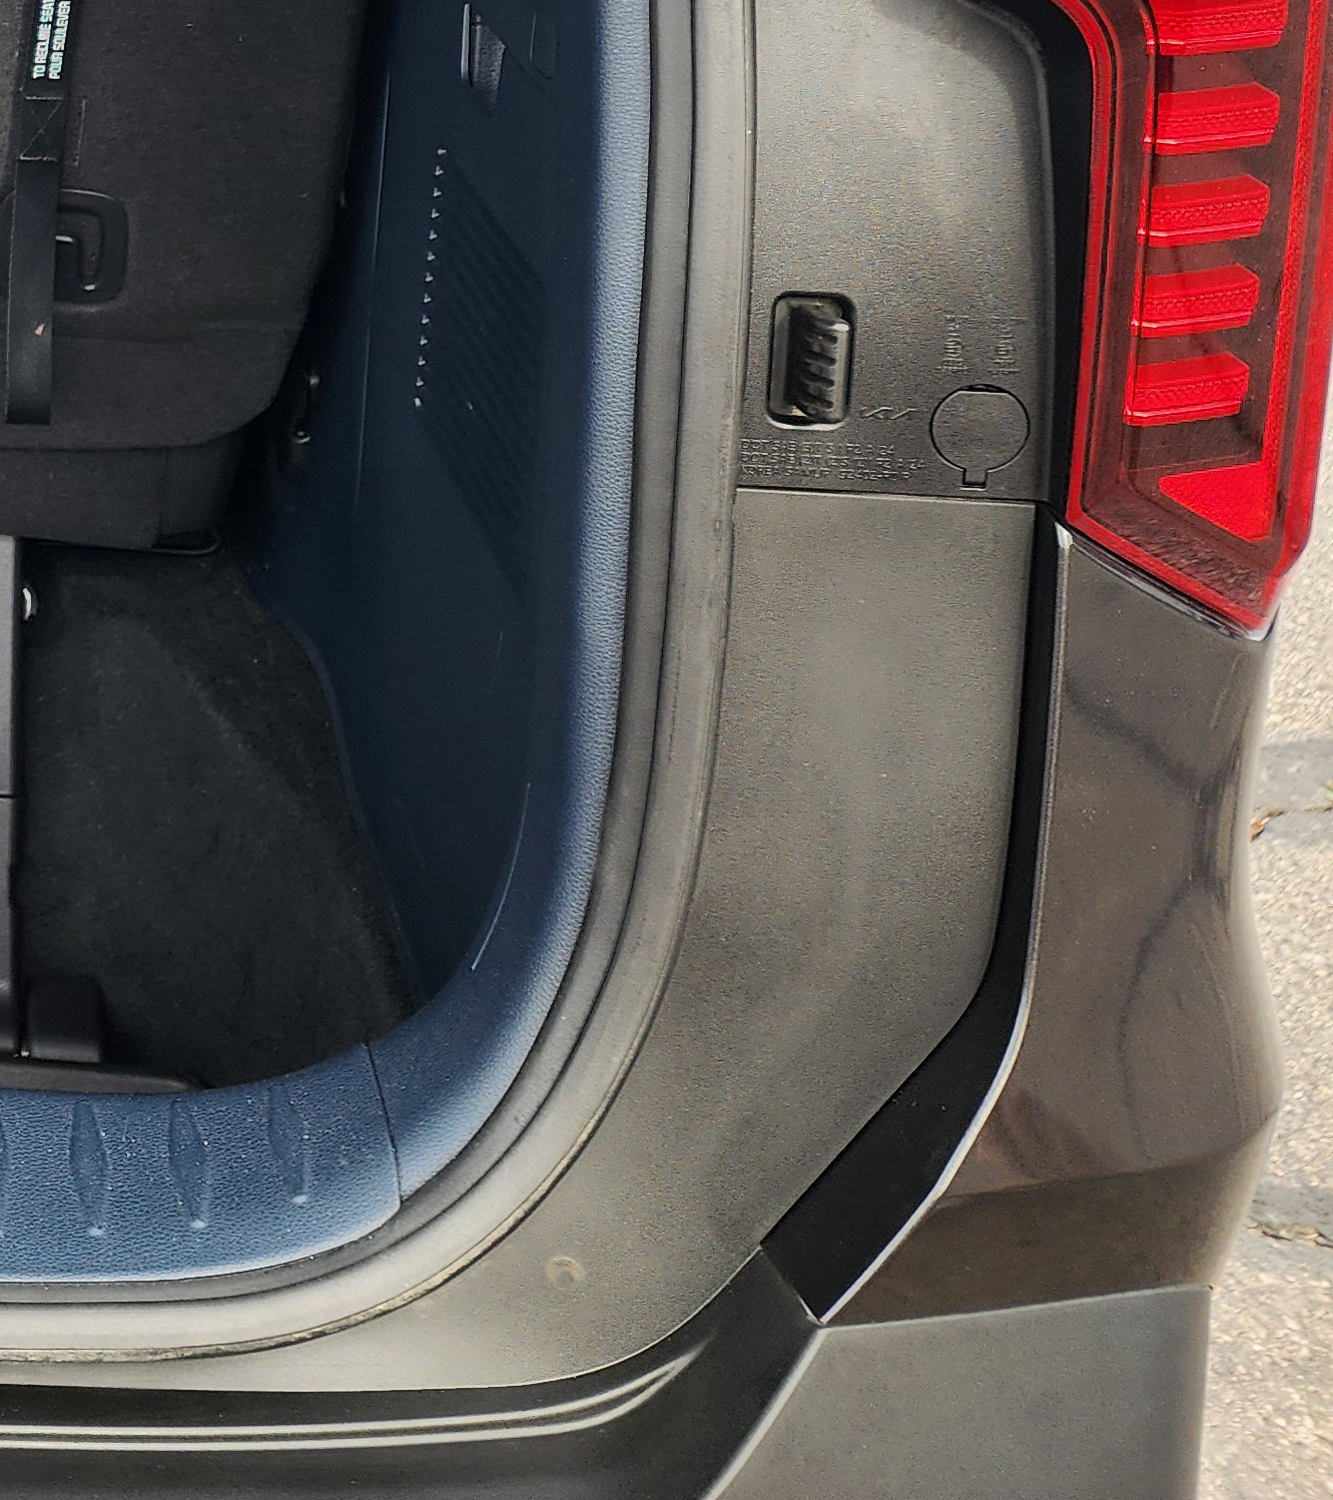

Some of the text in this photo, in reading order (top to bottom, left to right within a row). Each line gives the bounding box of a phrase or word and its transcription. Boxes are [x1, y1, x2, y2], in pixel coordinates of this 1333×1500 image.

[52, 1, 71, 50] SOULEVER
[34, 24, 51, 63] RECLINE
[32, 65, 46, 79] TO
[48, 52, 63, 79] POUR
